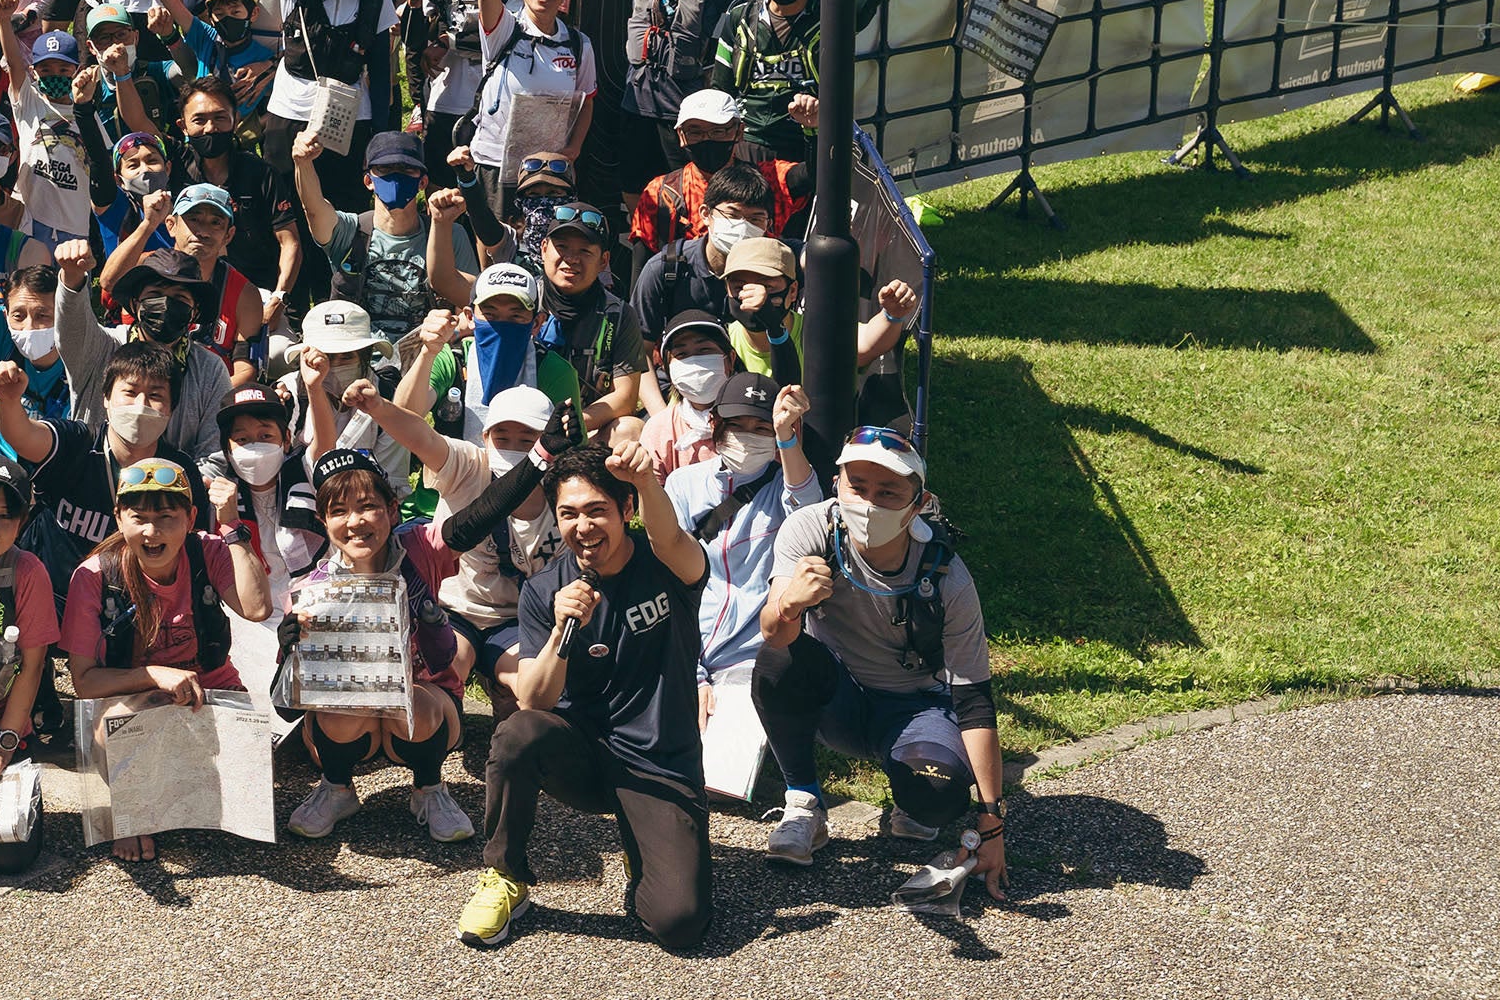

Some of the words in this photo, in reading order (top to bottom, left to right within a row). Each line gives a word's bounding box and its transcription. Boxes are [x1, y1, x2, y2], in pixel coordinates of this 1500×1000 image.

[234, 389, 267, 404] MARVEL
[319, 454, 355, 476] HELLO
[56, 498, 110, 543] CHU
[625, 591, 672, 632] FDG
